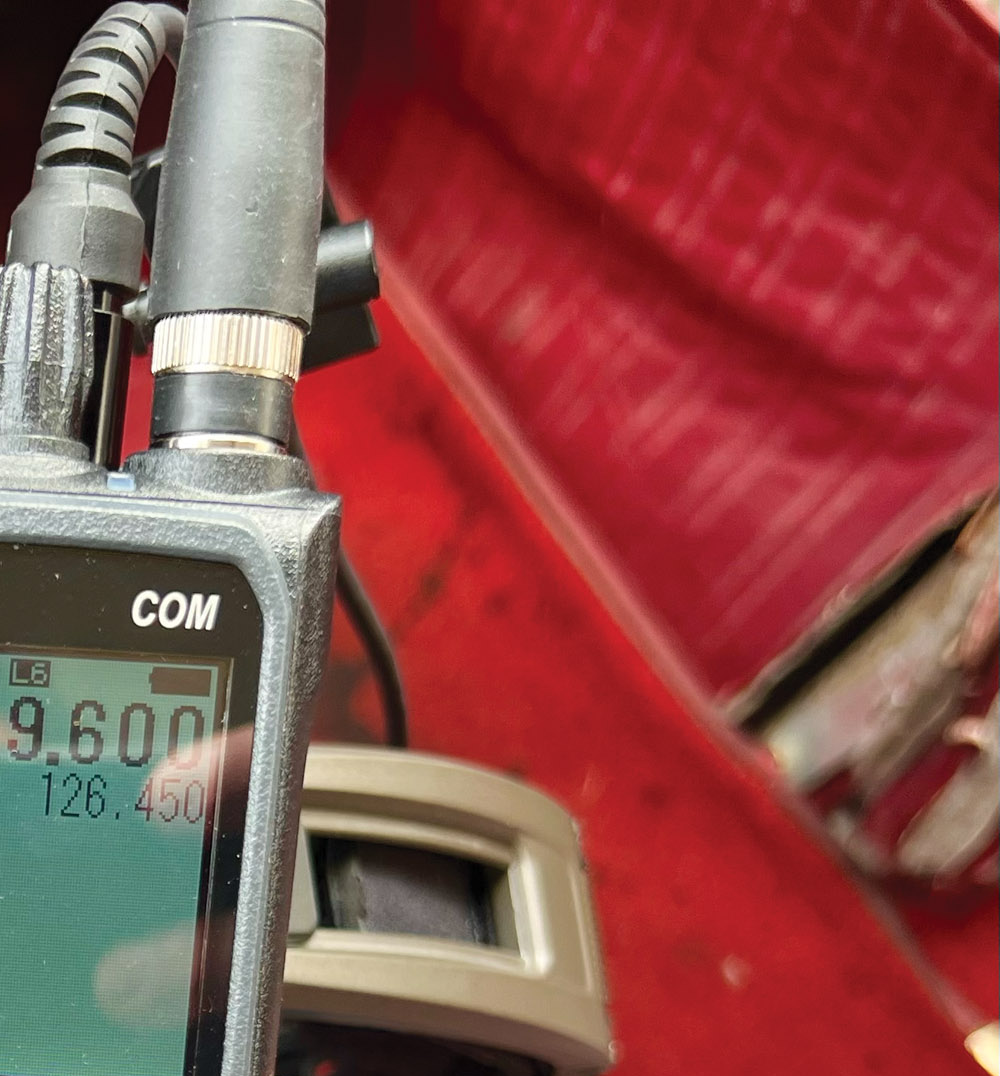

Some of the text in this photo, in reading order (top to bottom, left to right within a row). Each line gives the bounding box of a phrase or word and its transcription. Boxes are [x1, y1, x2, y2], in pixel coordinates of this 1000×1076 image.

[131, 589, 221, 631] COM
[10, 661, 49, 685] L6
[41, 772, 204, 824] 126.450
